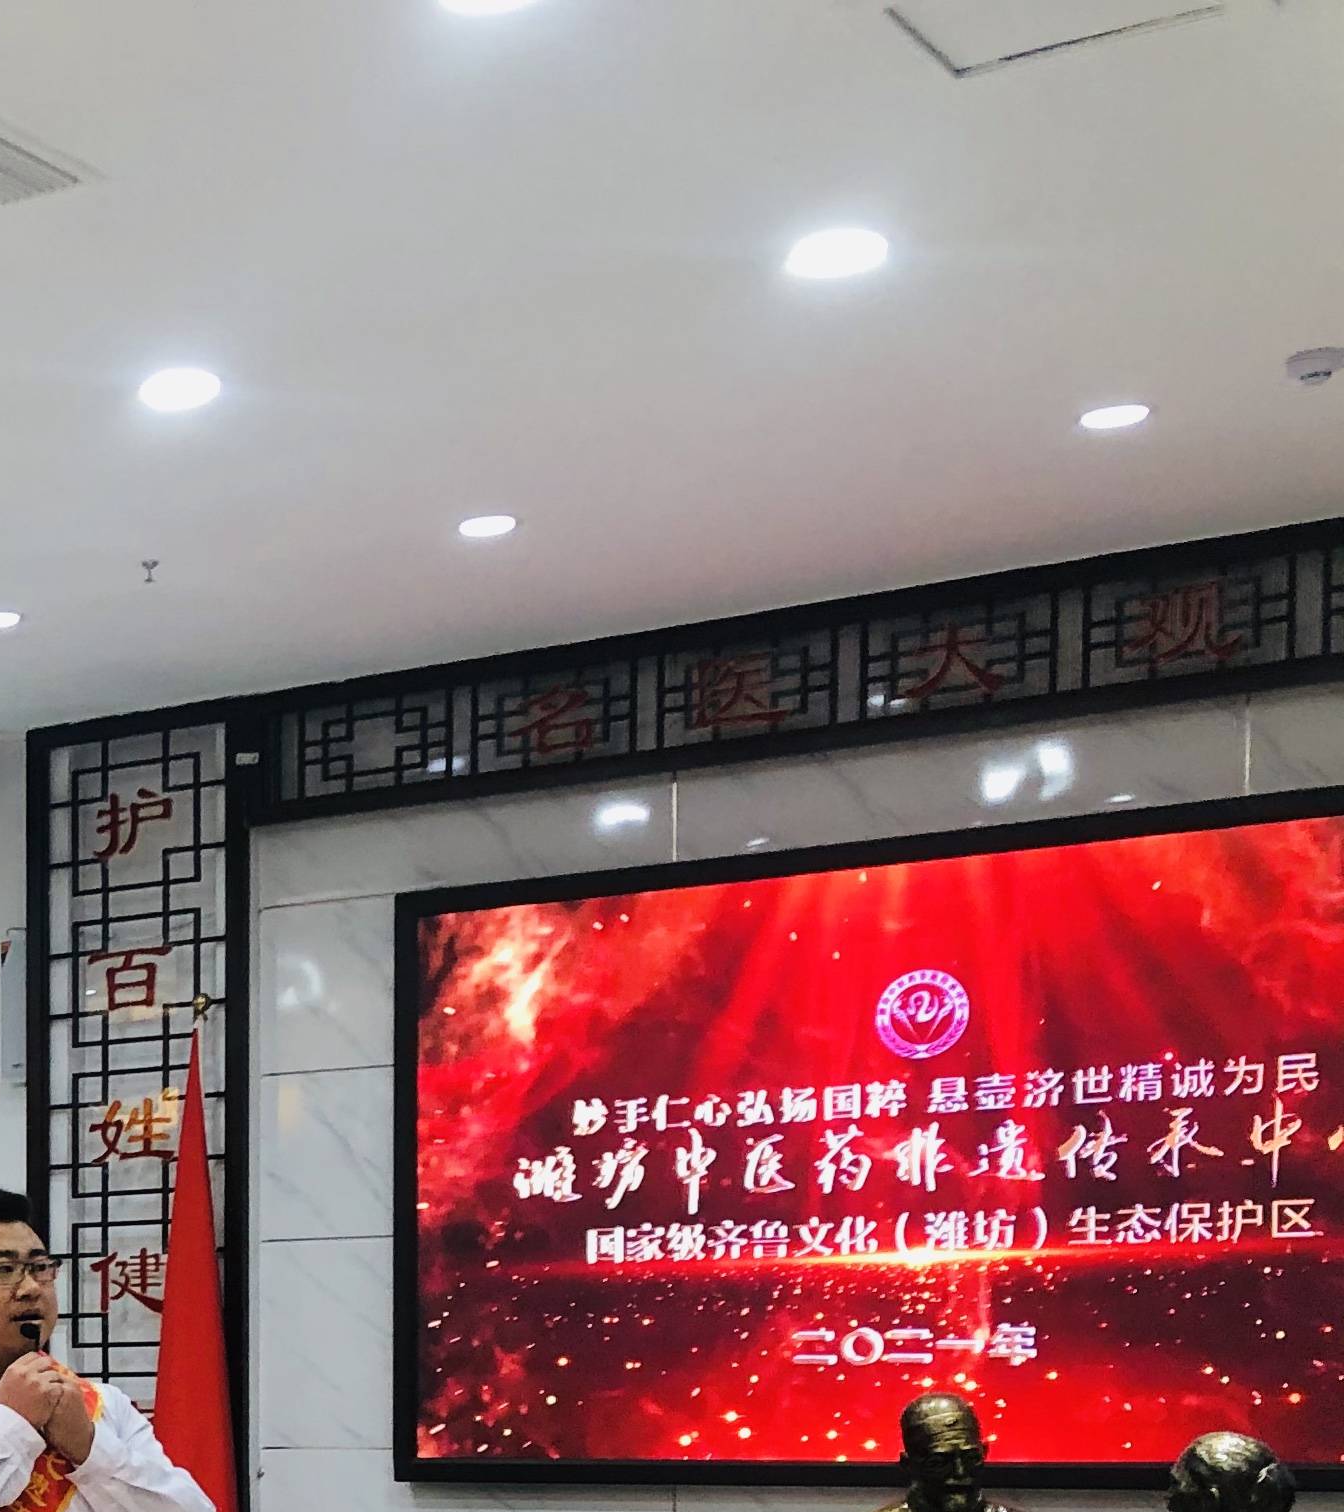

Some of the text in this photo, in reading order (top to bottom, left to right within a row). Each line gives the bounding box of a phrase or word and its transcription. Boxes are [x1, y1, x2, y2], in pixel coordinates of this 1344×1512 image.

[570, 1052, 1321, 1138] 妙手仁心弘扬国粹 悬壶济世精诚为民
[512, 1091, 1344, 1217] 潍坊中医药非遗传承中
[585, 1198, 1321, 1264] 国家级齐鲁文化（潍坊）生态保护区
